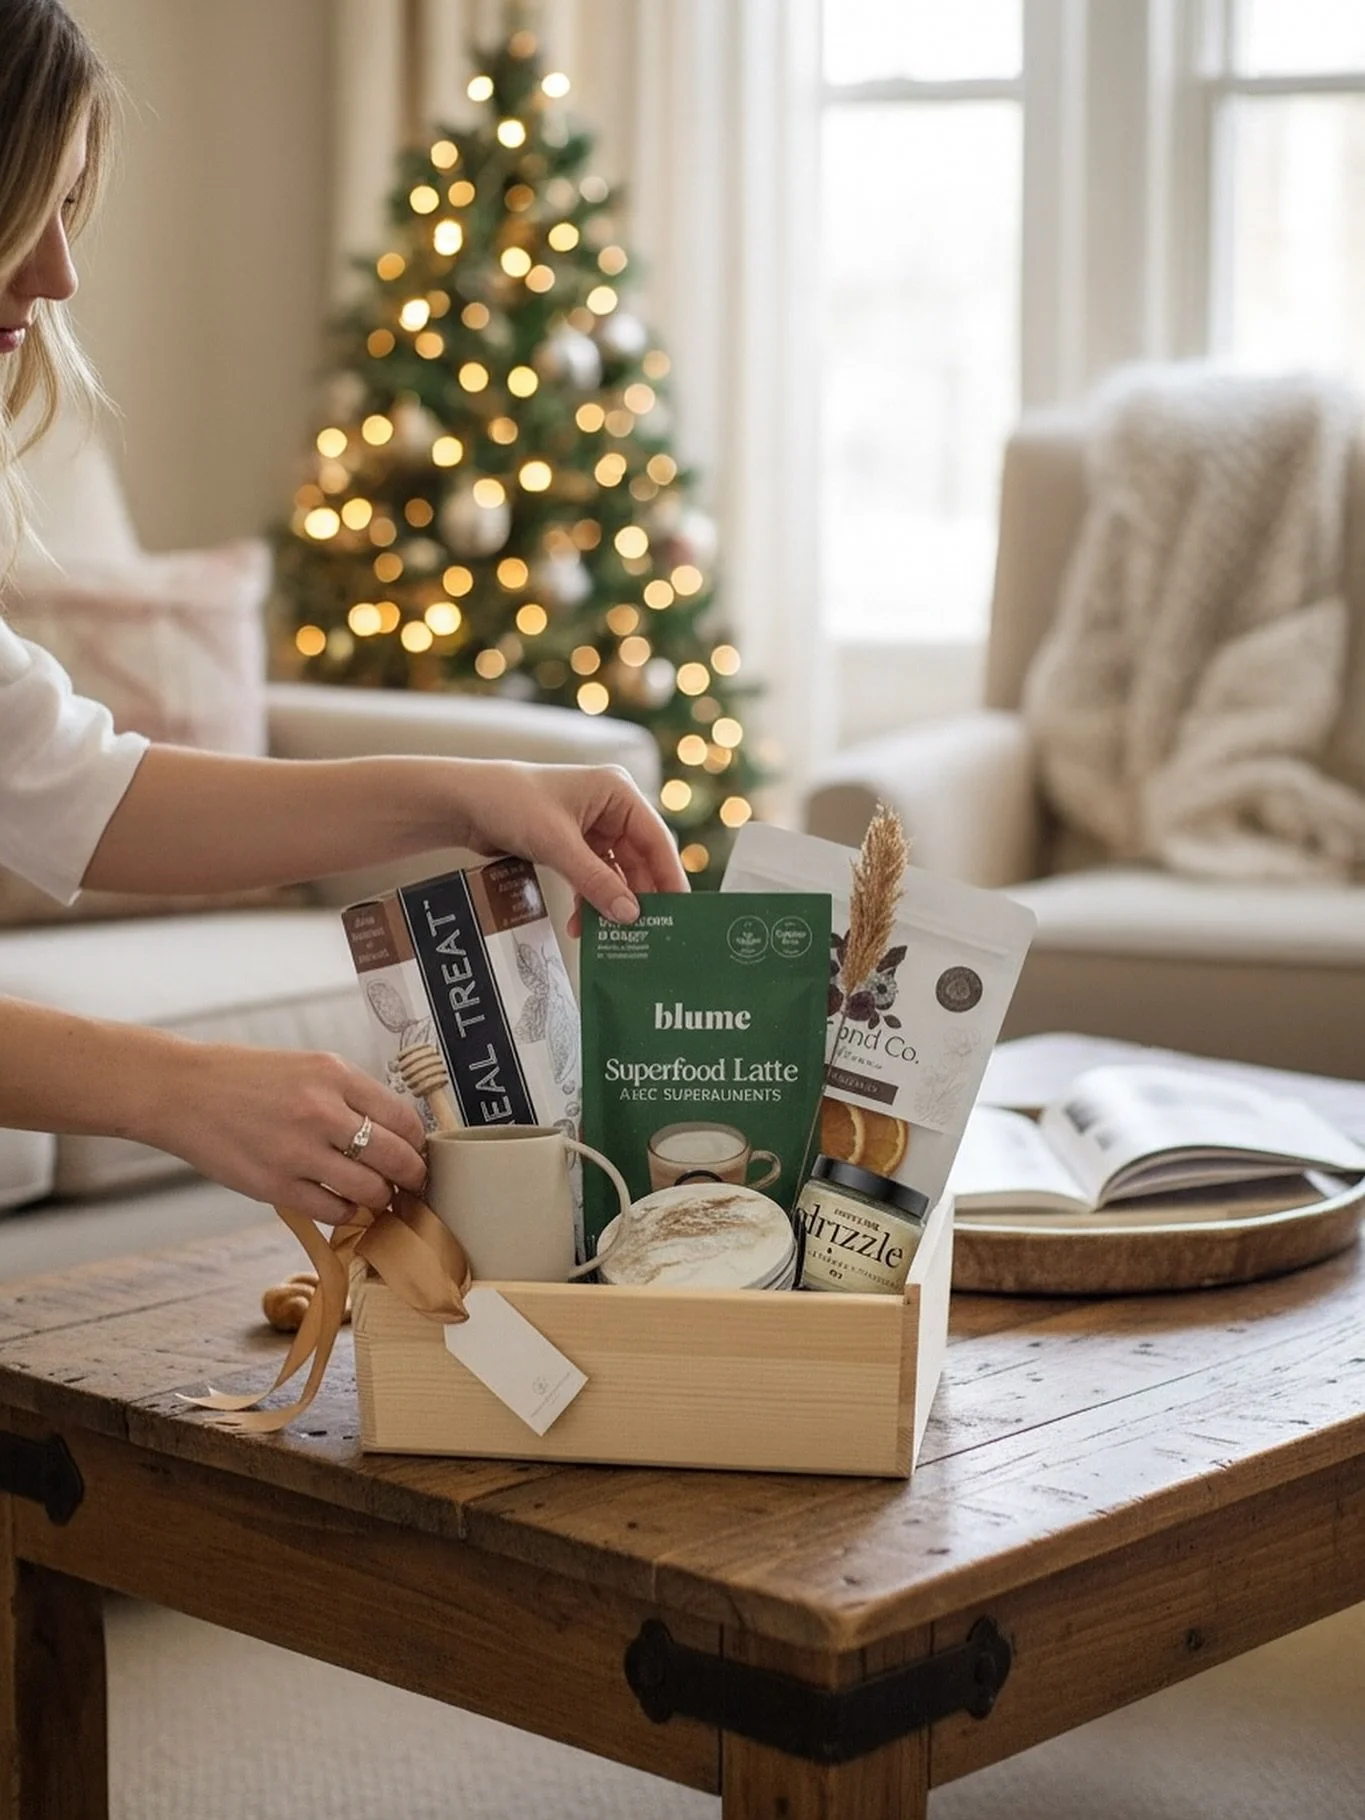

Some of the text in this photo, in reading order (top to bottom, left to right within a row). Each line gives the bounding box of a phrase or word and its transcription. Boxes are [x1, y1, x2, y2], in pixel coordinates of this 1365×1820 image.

[654, 1002, 751, 1030] blume
[884, 1035, 920, 1065] Co.
[469, 1043, 516, 1125] EAL
[604, 1056, 799, 1087] Superfood Latte
